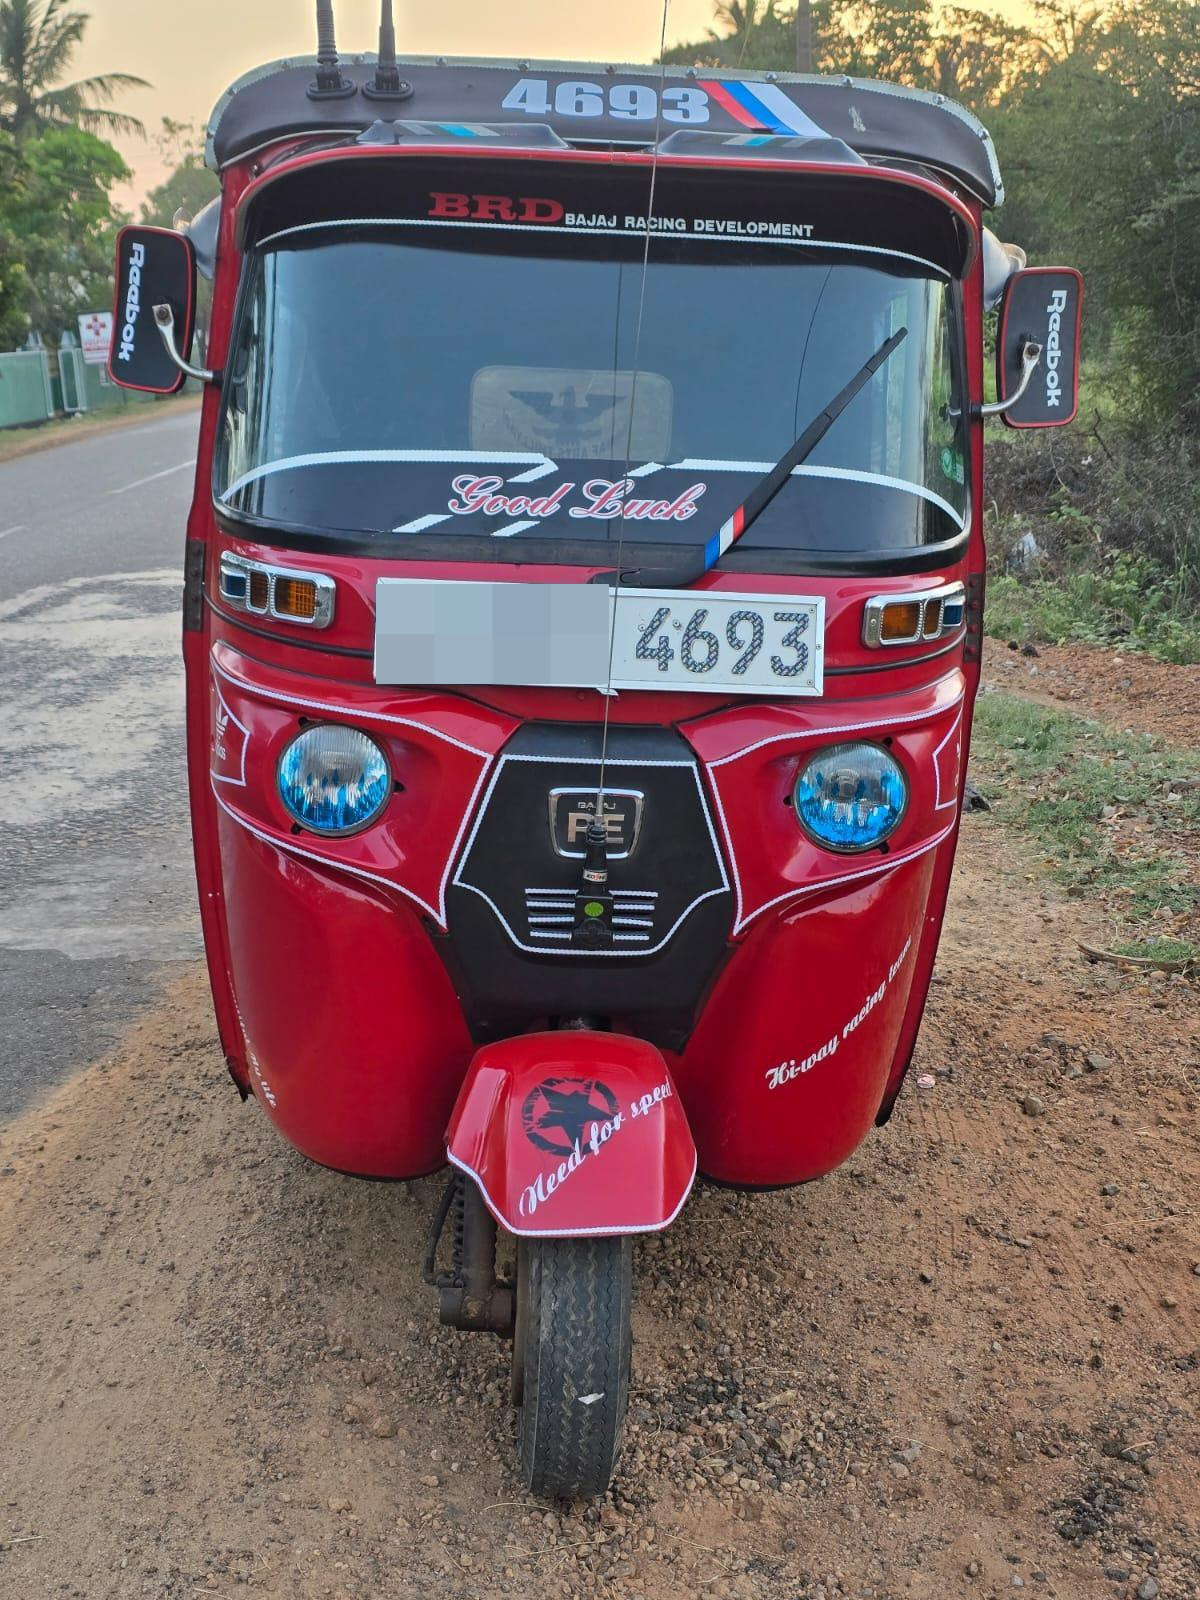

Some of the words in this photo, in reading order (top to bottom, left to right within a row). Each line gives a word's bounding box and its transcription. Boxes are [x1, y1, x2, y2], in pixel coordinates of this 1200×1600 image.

[502, 78, 710, 124] 4693
[427, 191, 564, 222] BRD
[565, 213, 618, 229] BAJAJ
[625, 215, 687, 232] RACING
[693, 219, 814, 238] DEVELOPMENT
[118, 242, 145, 363] Reebok
[1046, 289, 1068, 407] Reebok
[448, 474, 576, 518] Good
[568, 478, 707, 522] Luck
[635, 606, 810, 677] 4693
[577, 801, 617, 810] BAAJ
[765, 1035, 840, 1090] Hi-way
[842, 980, 888, 1039] racing
[519, 1136, 586, 1217] Need
[589, 1112, 626, 1156] for
[630, 1075, 673, 1118] speed
